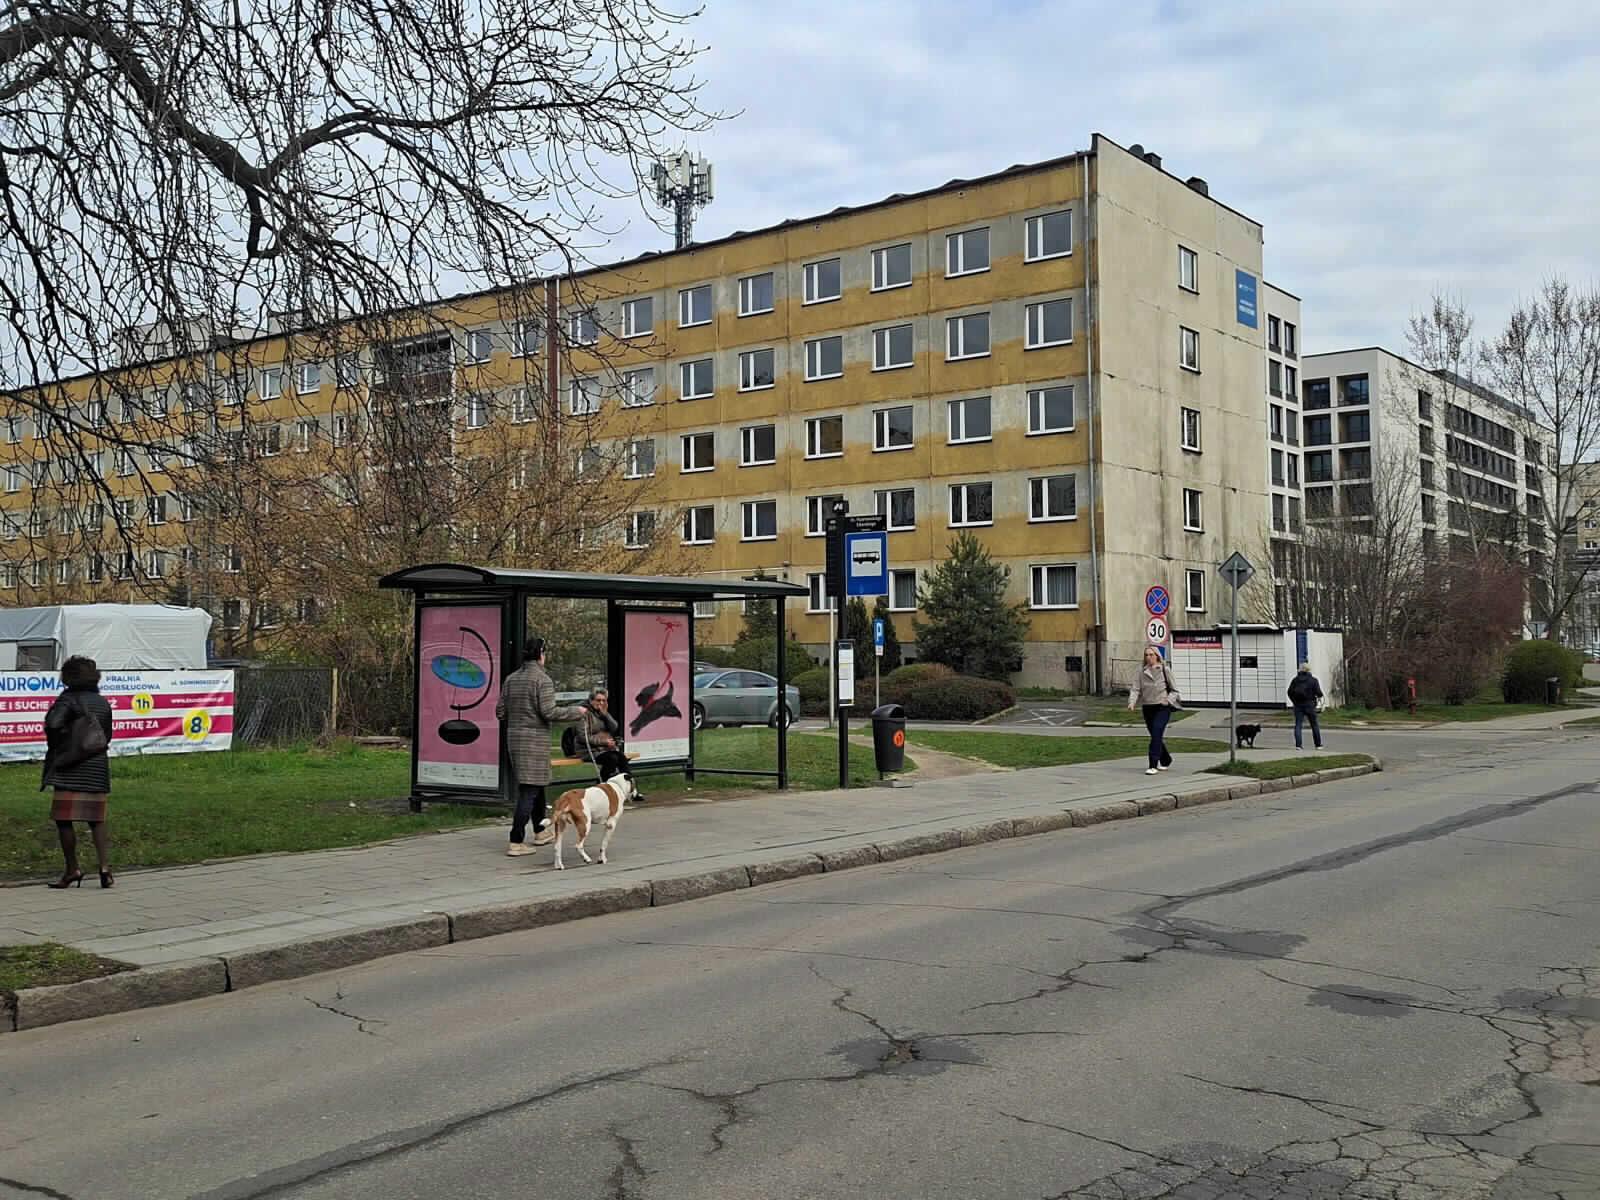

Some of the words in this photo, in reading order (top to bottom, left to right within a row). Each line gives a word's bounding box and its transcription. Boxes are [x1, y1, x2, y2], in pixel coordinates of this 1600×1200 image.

[876, 622, 883, 641] P
[1150, 623, 1165, 638] 30
[15, 701, 50, 710] SUCHE
[136, 697, 150, 709] 1h
[146, 720, 159, 729] ZA
[191, 716, 202, 733] 8
